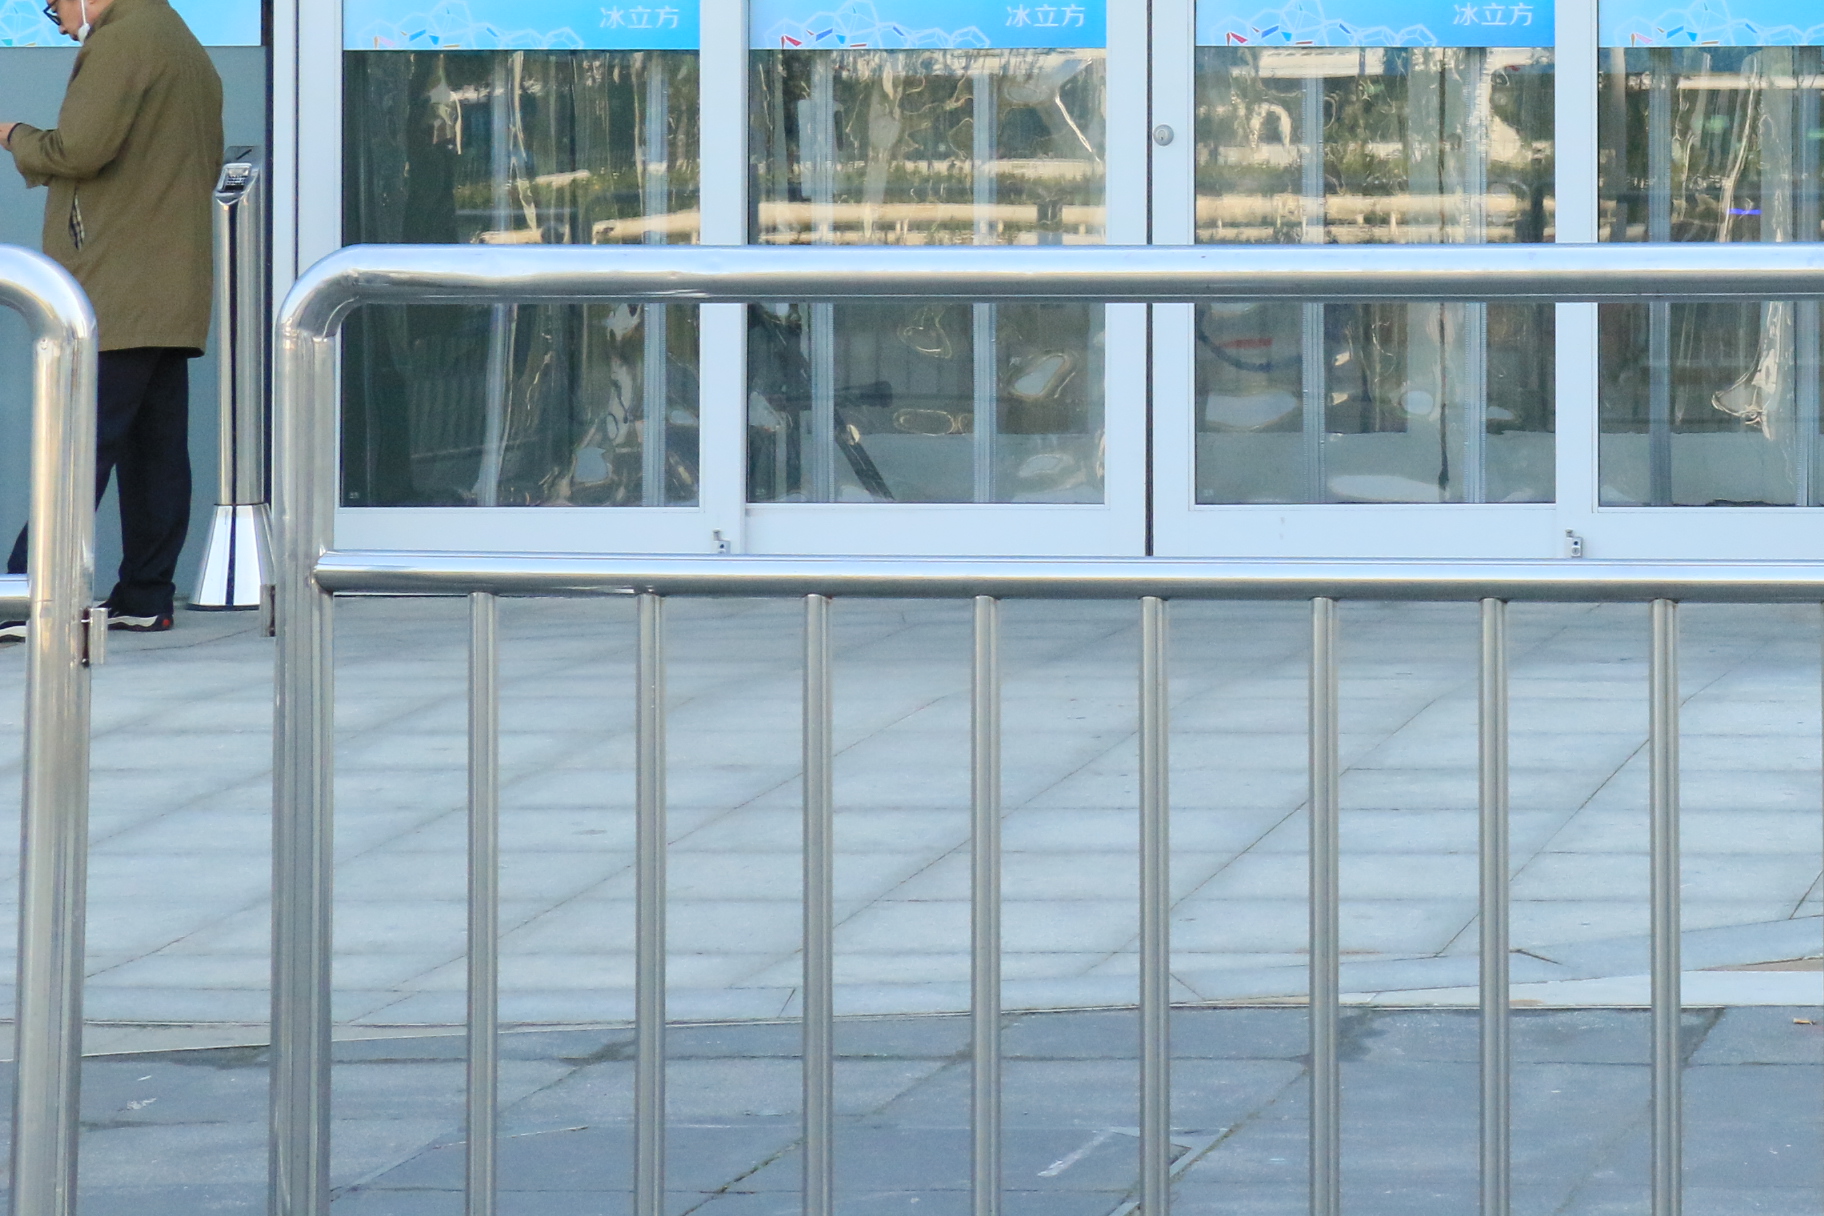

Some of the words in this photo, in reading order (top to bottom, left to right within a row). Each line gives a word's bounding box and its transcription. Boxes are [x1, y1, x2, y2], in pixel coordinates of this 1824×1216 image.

[600, 5, 680, 29] 冰立方
[1005, 3, 1086, 27] 冰立方
[1453, 2, 1534, 26] 冰立方
